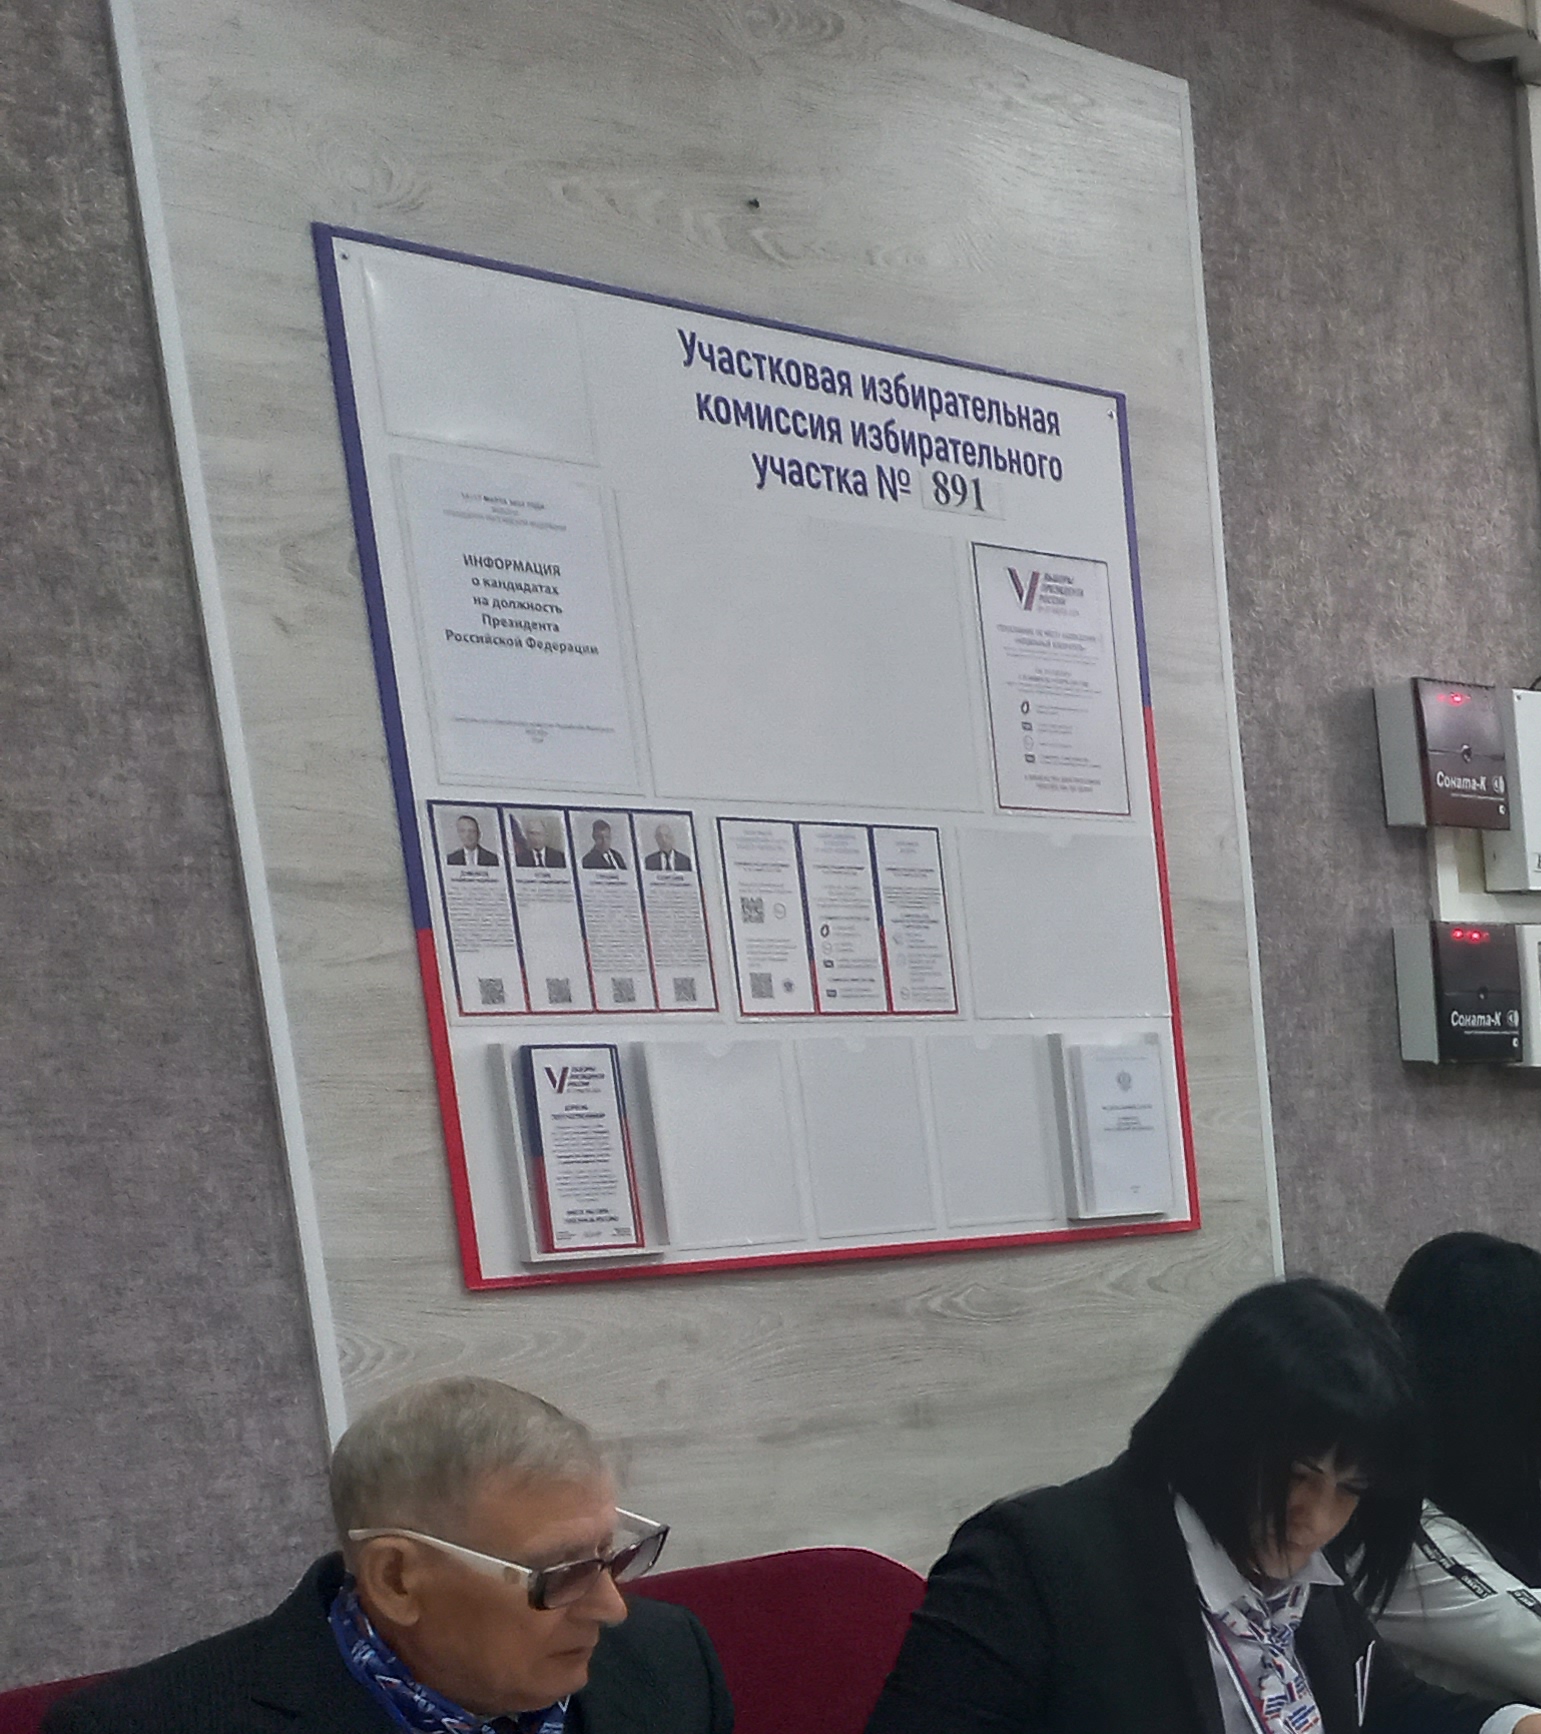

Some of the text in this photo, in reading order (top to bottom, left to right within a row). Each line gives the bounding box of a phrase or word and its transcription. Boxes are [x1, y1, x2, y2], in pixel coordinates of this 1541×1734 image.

[677, 328, 1061, 437] Участковая избирательная
[695, 392, 1064, 482] комиссия избирательного
[752, 452, 986, 512] участка № 891
[462, 553, 561, 577] ИНФОРМАЦИЯ
[483, 579, 559, 596] кандидатах
[473, 596, 564, 615] на должность
[482, 613, 560, 633] Президента
[445, 628, 600, 656] Российской Федерации
